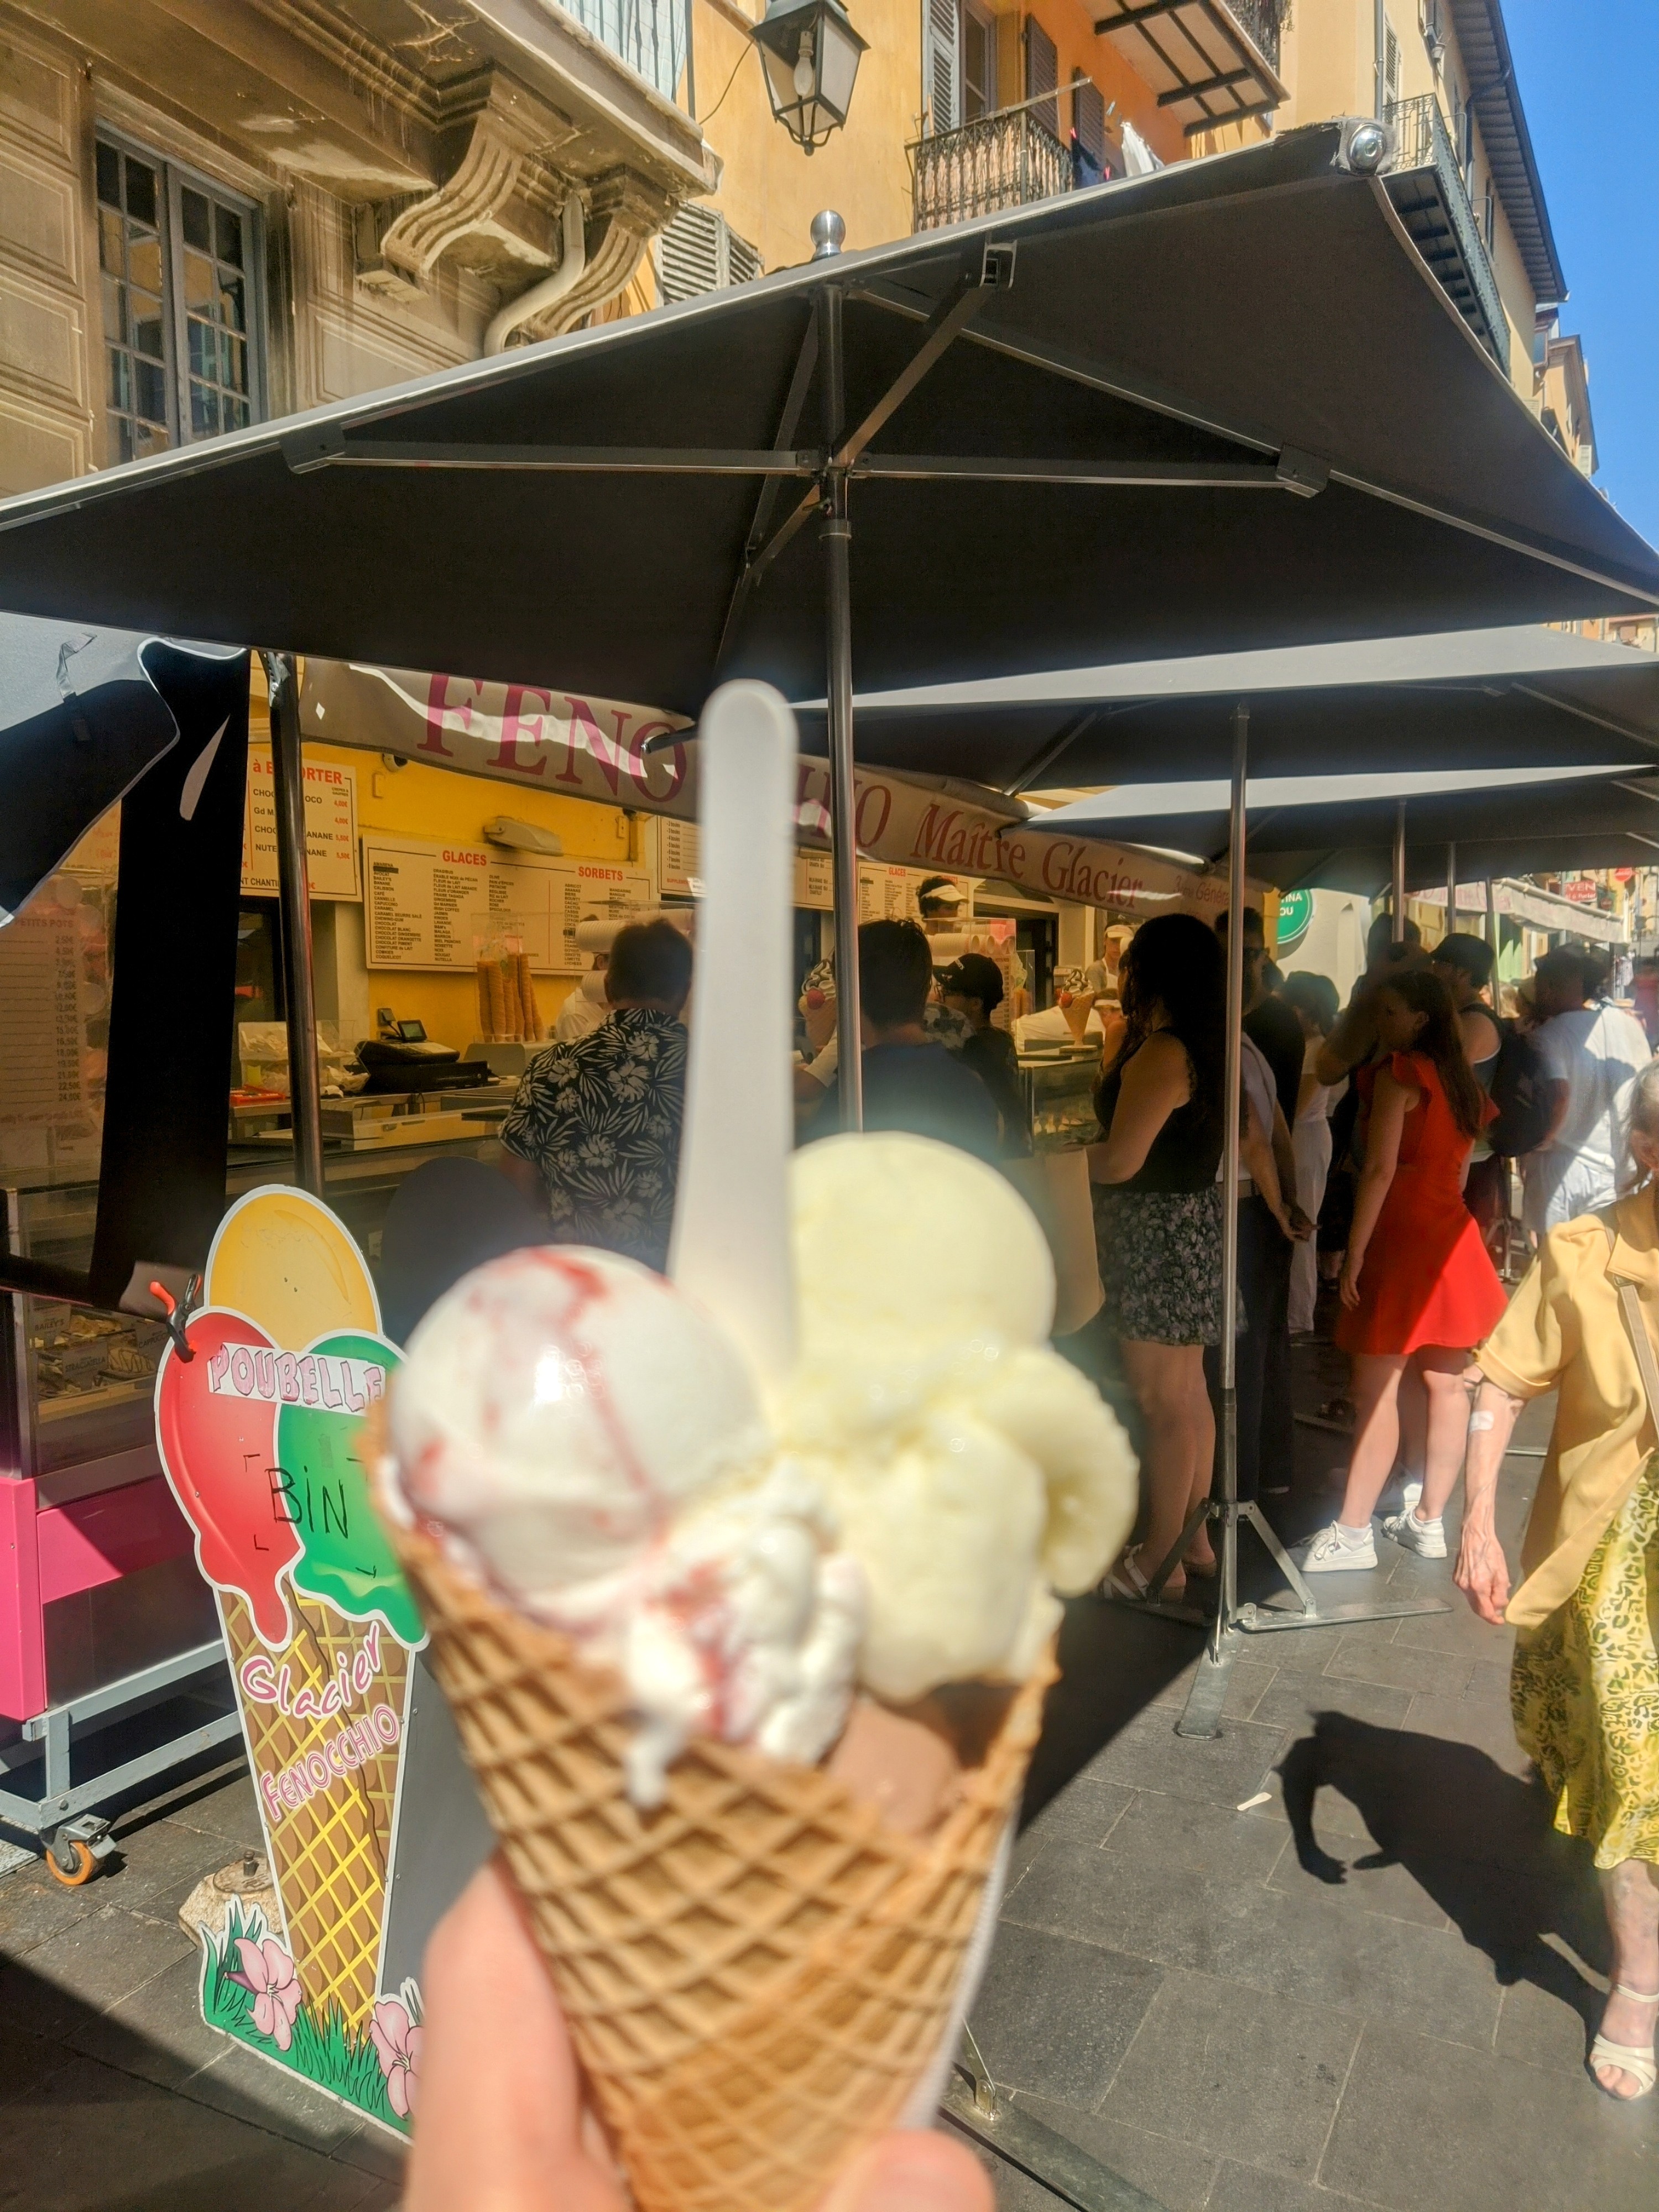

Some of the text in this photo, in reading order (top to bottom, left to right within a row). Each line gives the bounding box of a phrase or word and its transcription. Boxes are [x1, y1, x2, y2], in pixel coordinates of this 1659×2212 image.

[253, 759, 261, 773] à
[306, 831, 333, 840] ANANE
[443, 851, 487, 866] GLACES
[910, 804, 1024, 879] Maître
[1042, 841, 1144, 908] Glacier
[578, 867, 623, 881] SORBETS
[889, 867, 906, 877] GLACES
[210, 1344, 382, 1412] POUBELLE
[242, 1623, 378, 1717] Glacier
[260, 1705, 399, 1820] FENOCCHIO
